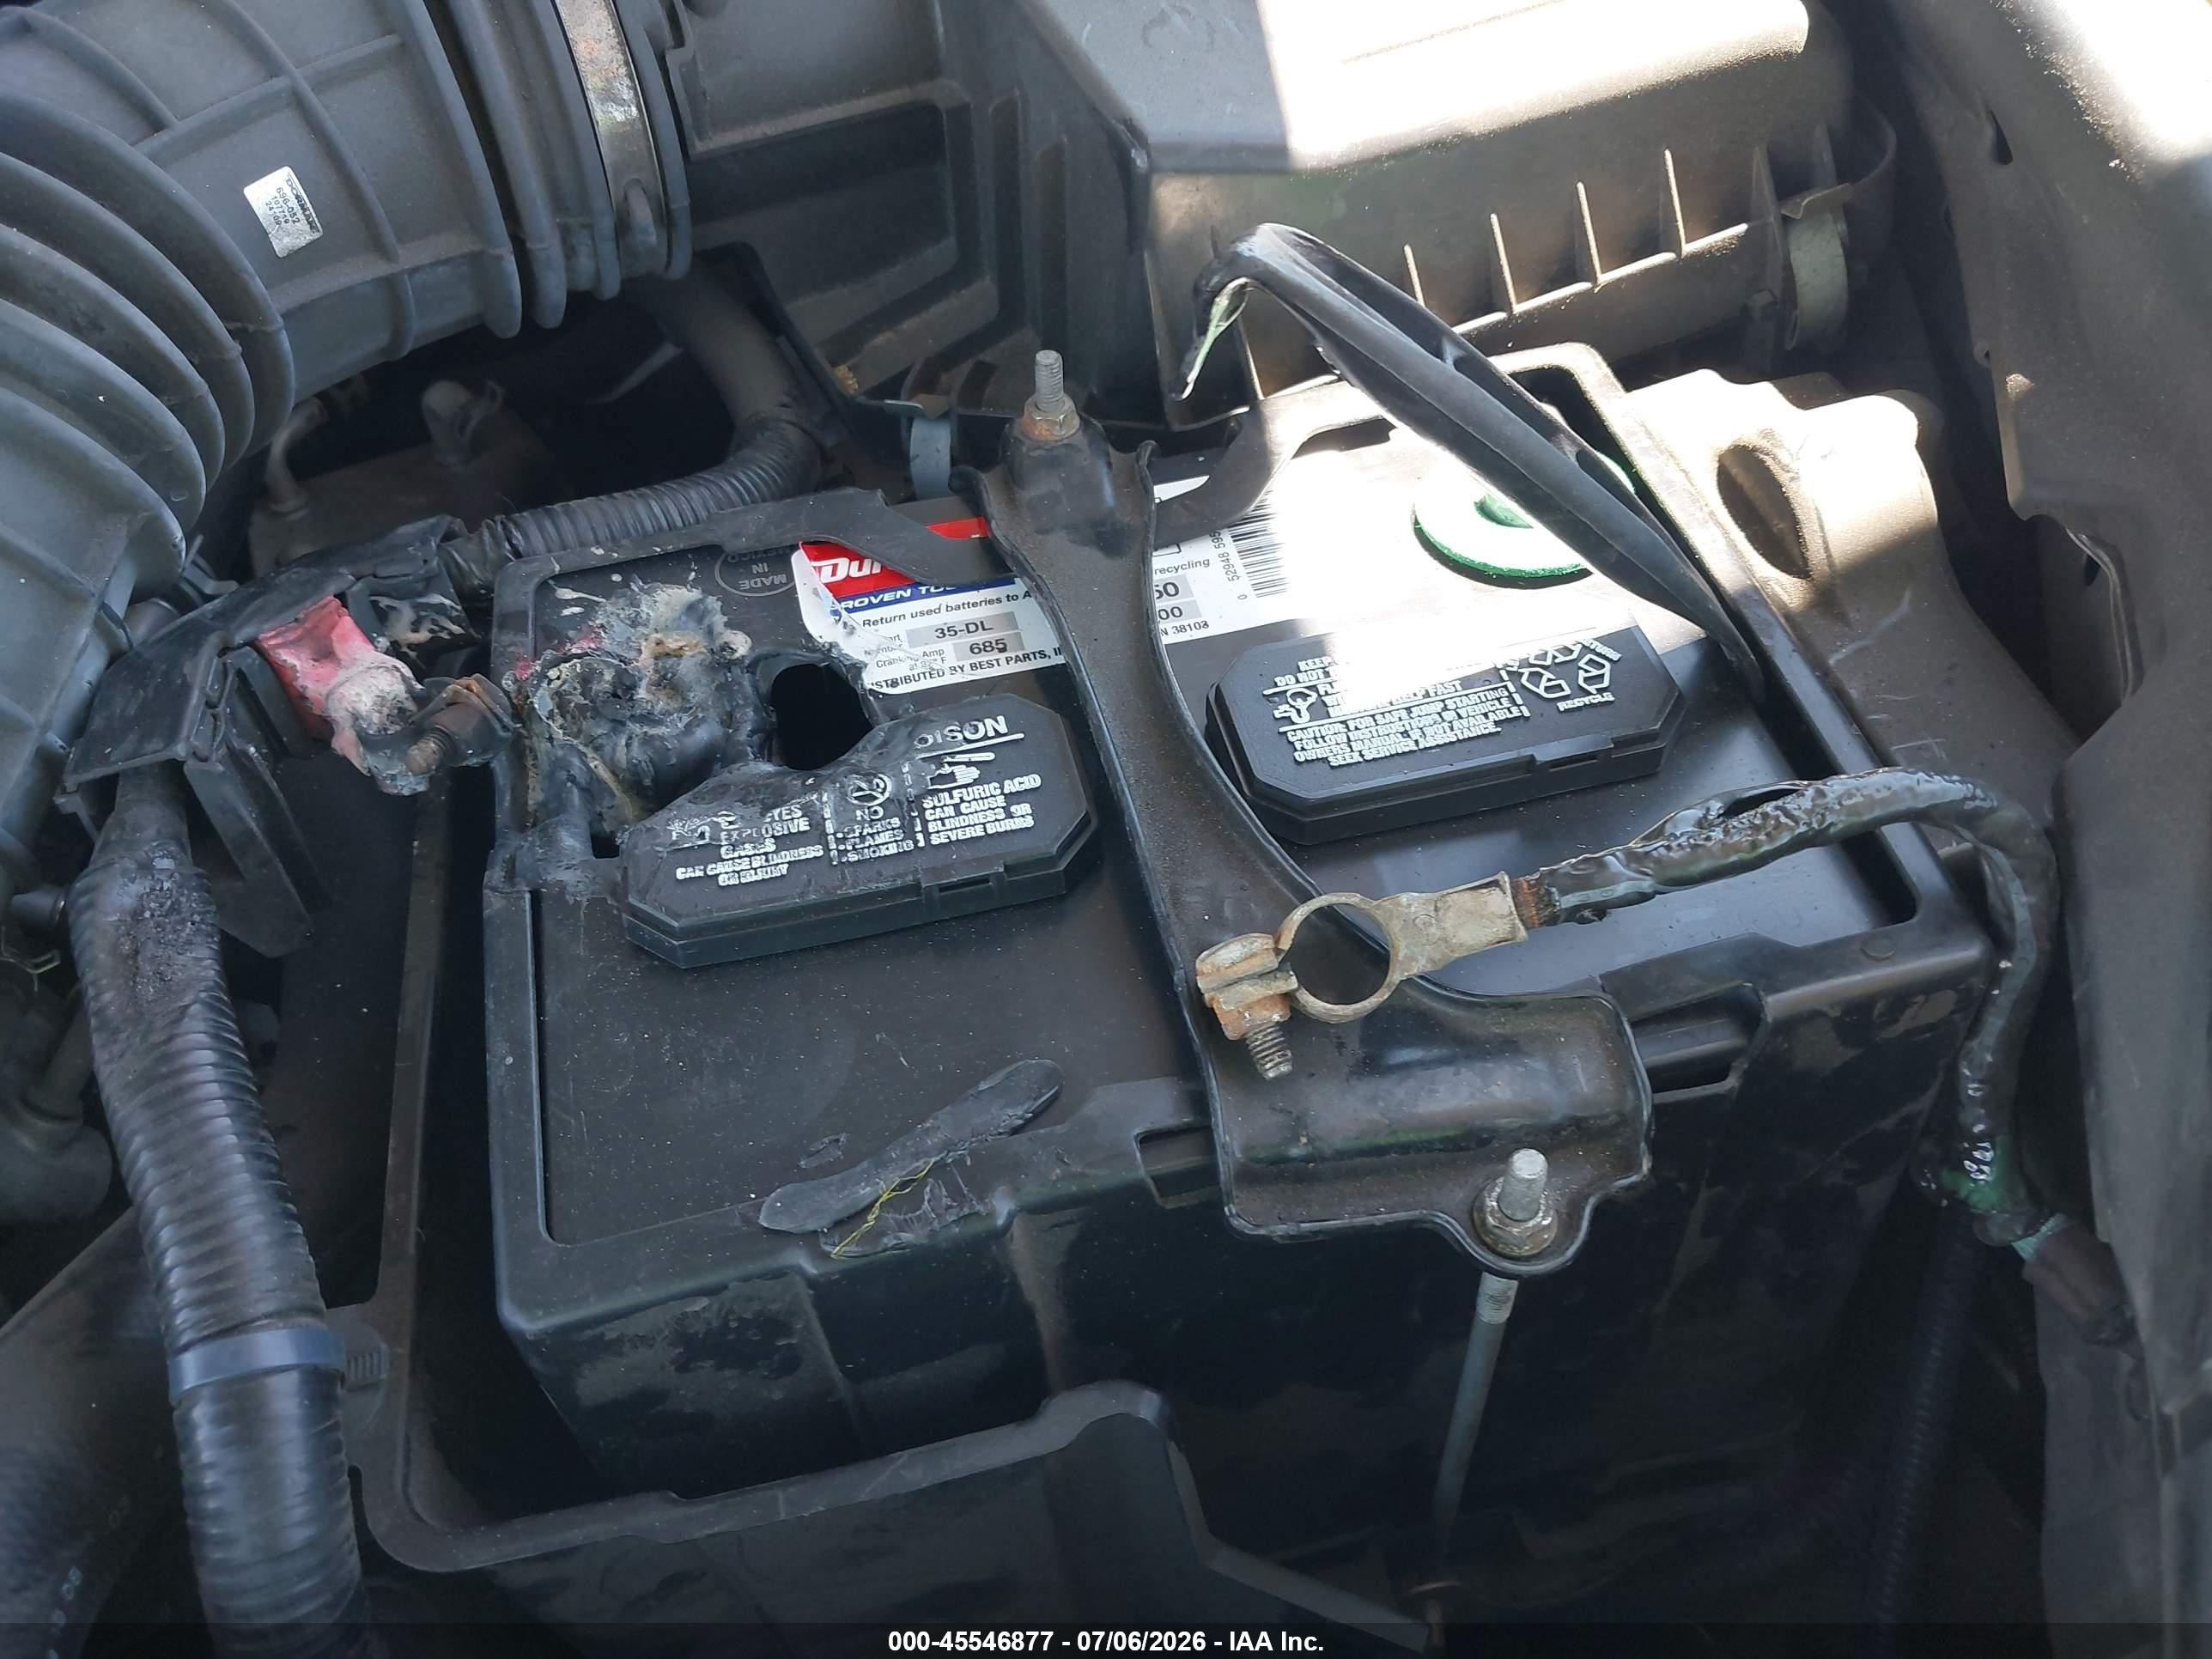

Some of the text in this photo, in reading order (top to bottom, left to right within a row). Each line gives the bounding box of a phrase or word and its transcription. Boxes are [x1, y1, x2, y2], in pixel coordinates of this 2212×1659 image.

[751, 562, 769, 574] IN
[1154, 559, 1210, 575] recycling
[1218, 551, 1241, 582] 52948
[738, 574, 787, 590] MADE
[862, 612, 906, 628] Return
[910, 603, 943, 619] used
[945, 597, 1003, 612] batteries
[1006, 593, 1020, 603] to
[934, 620, 994, 639] 35-DL
[922, 647, 945, 659] Amp
[969, 638, 1008, 655] 685
[1580, 639, 1622, 661] ETURN
[969, 656, 1002, 672] BEST
[1004, 649, 1052, 666] PARTS,
[1426, 680, 1463, 697] FAST
[1445, 687, 1509, 710] STARTING
[1556, 692, 1615, 712] RECYCLE
[1293, 732, 1347, 750] FOLLOW
[1457, 697, 1512, 716] VEHICLE
[1452, 706, 1522, 732] AVAILABLE
[914, 715, 1009, 749] OISON
[1361, 740, 1419, 760] SERVICE
[921, 774, 1042, 809] SULFURIC ACID
[855, 805, 884, 821] NO
[925, 795, 1007, 821] CAN CAUSE
[927, 807, 1006, 834] BLINDNESS
[930, 815, 1035, 846] SEVERE BURNS
[720, 837, 777, 860] GASES
